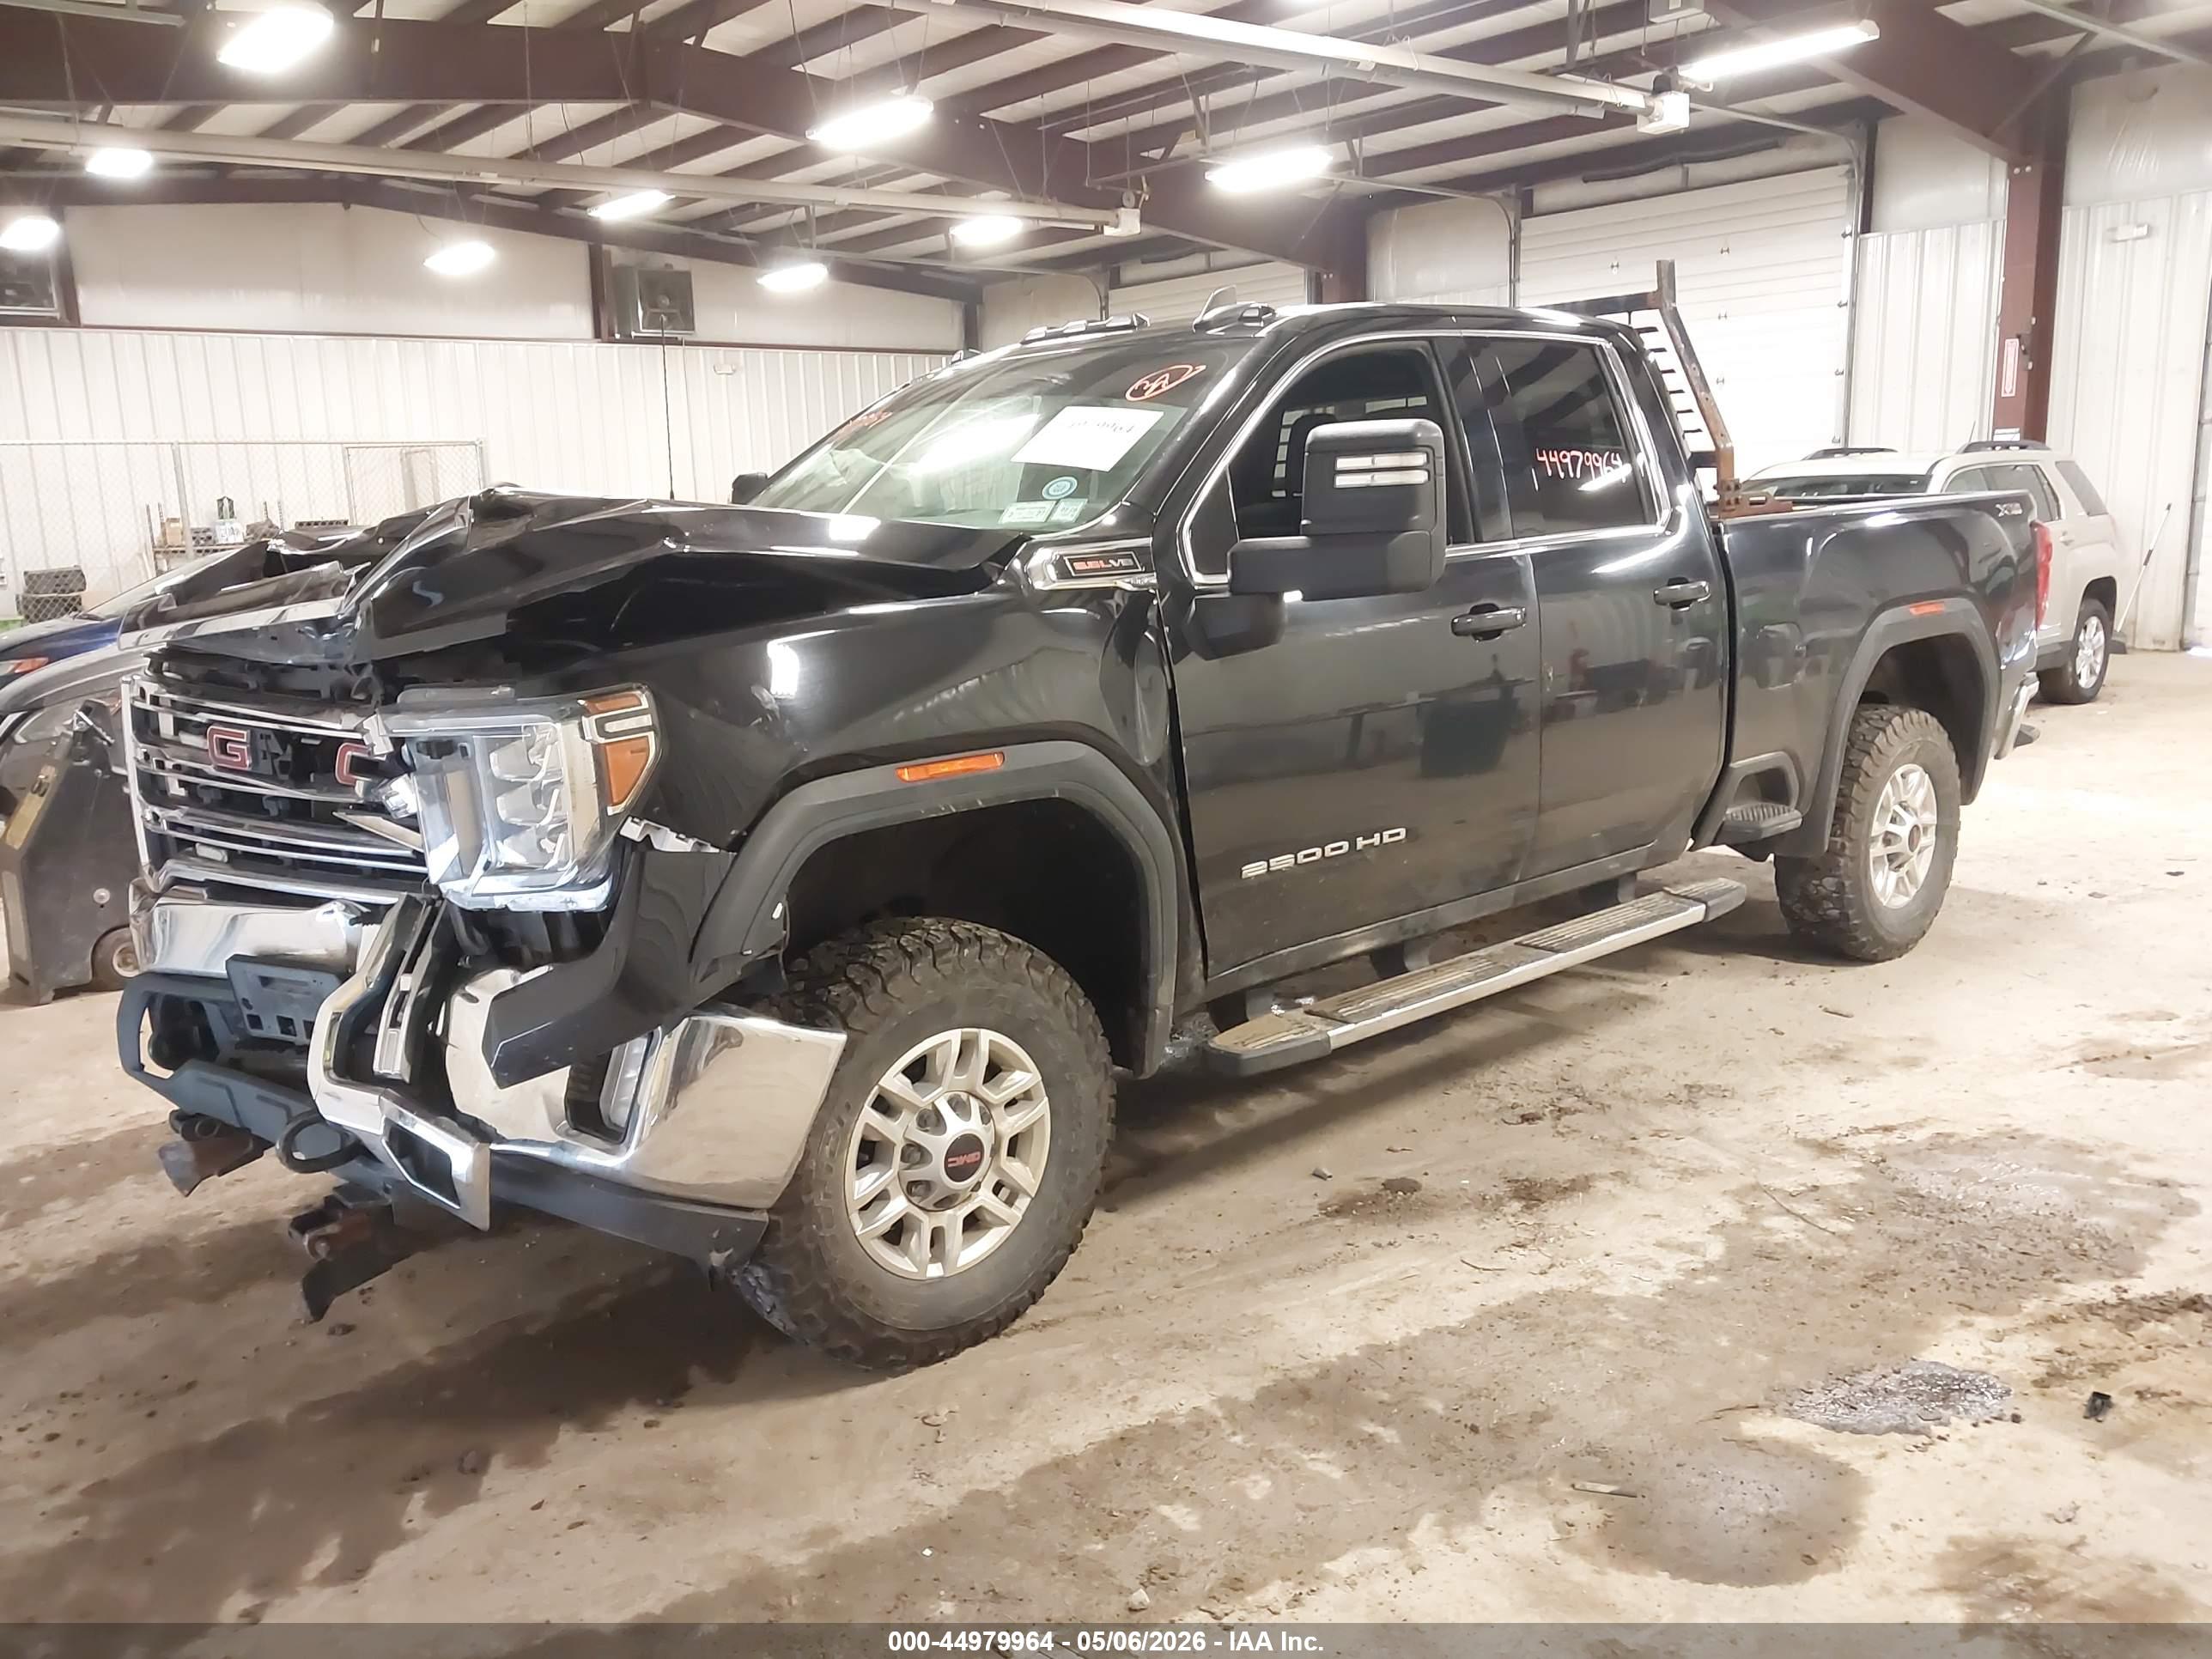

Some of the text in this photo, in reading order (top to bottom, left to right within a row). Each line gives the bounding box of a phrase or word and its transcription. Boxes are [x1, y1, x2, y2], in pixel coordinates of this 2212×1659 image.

[1535, 448, 1626, 483] 44979964
[1242, 827, 1407, 879] 2500 HD
